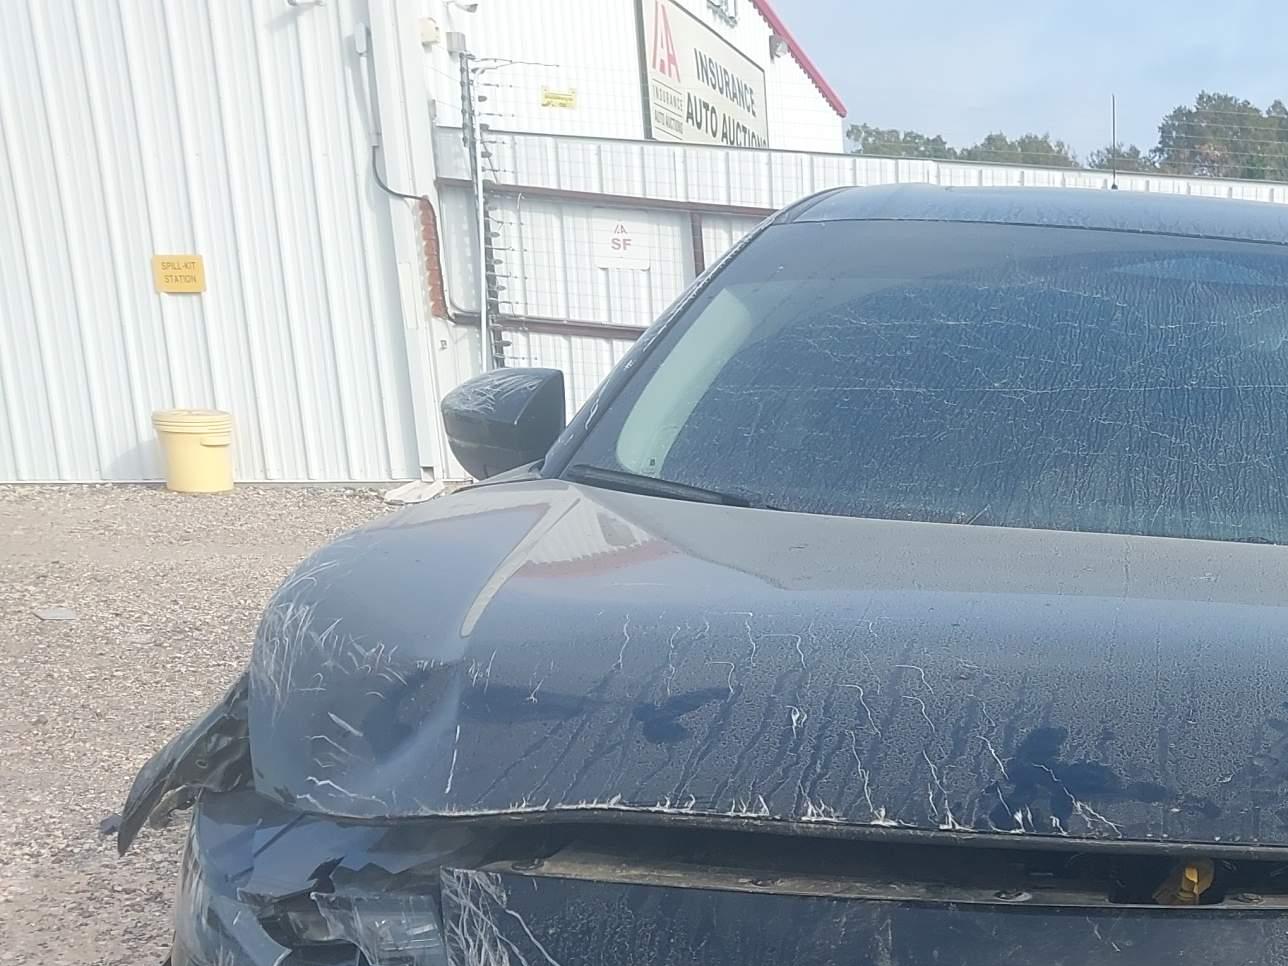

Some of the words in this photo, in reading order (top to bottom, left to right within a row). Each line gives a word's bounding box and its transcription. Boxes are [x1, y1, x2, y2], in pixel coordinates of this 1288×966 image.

[693, 47, 757, 118] INSURANCE
[685, 91, 718, 139] AUTO
[611, 237, 632, 251] SF
[163, 274, 197, 284] STATION
